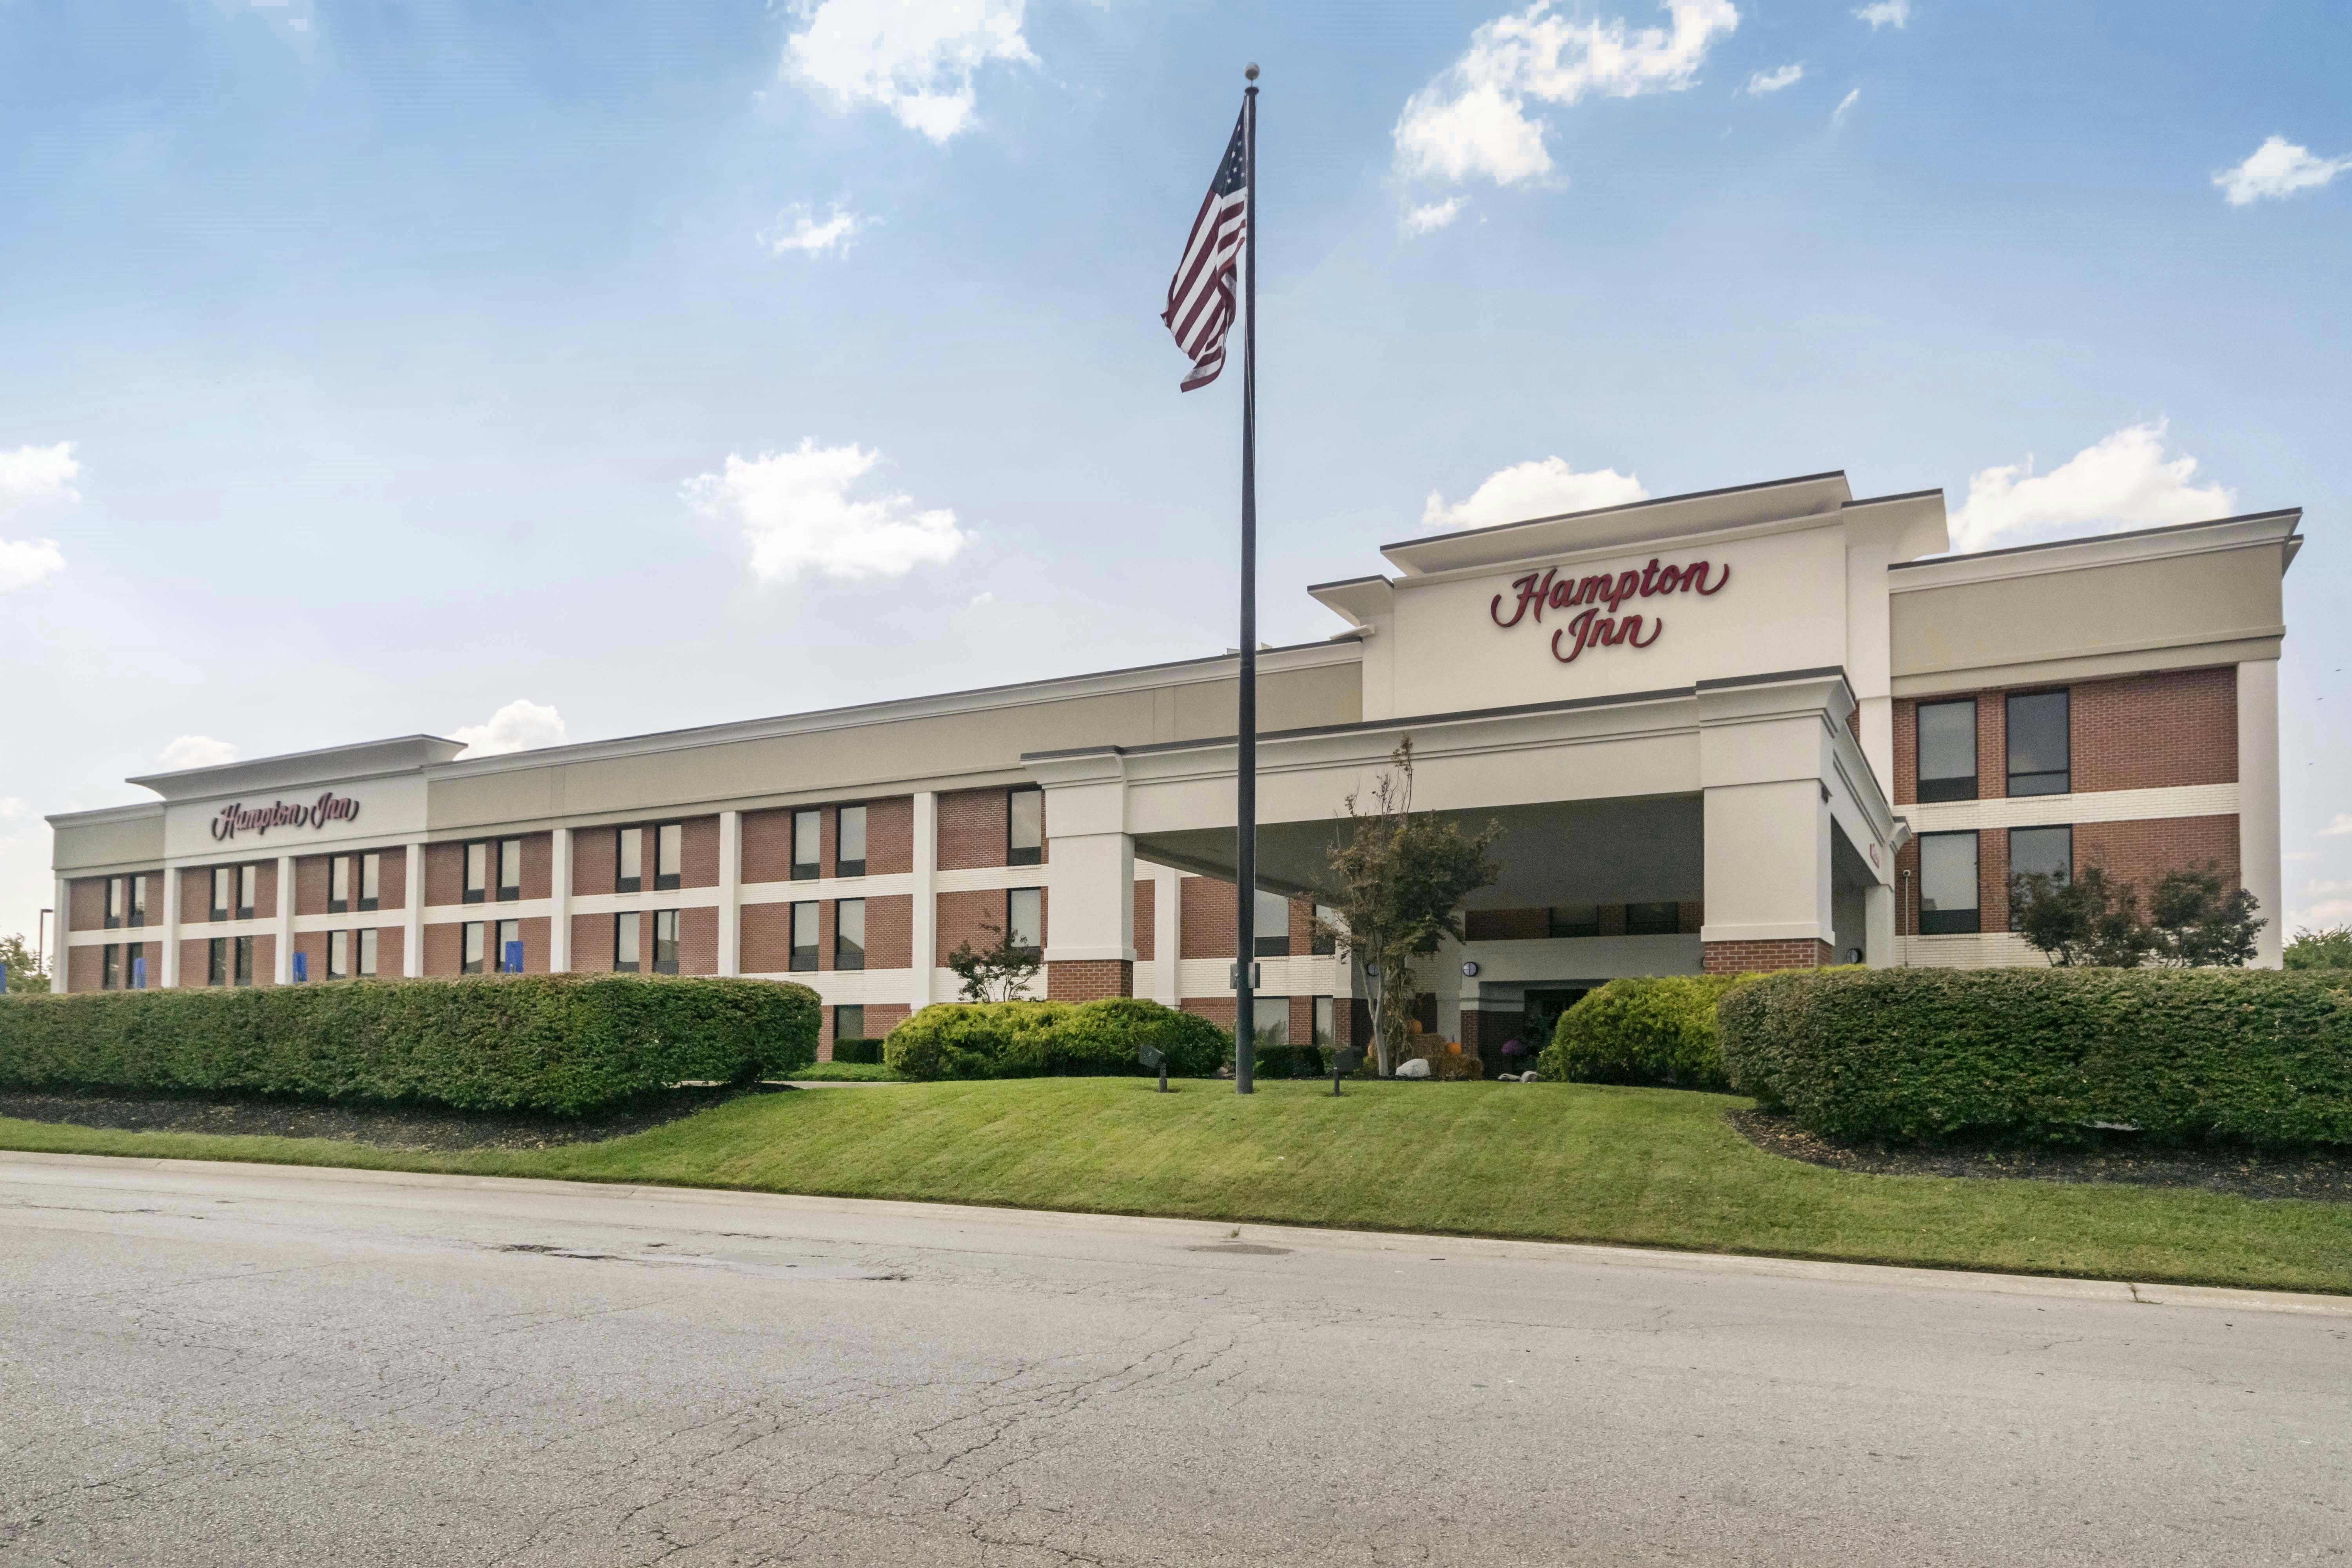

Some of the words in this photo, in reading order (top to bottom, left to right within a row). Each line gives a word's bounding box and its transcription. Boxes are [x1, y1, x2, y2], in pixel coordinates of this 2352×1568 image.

[1491, 559, 1730, 628] Hampton
[1552, 608, 1662, 663] Inn
[211, 800, 308, 840] Hampton
[310, 792, 359, 829] Inn
